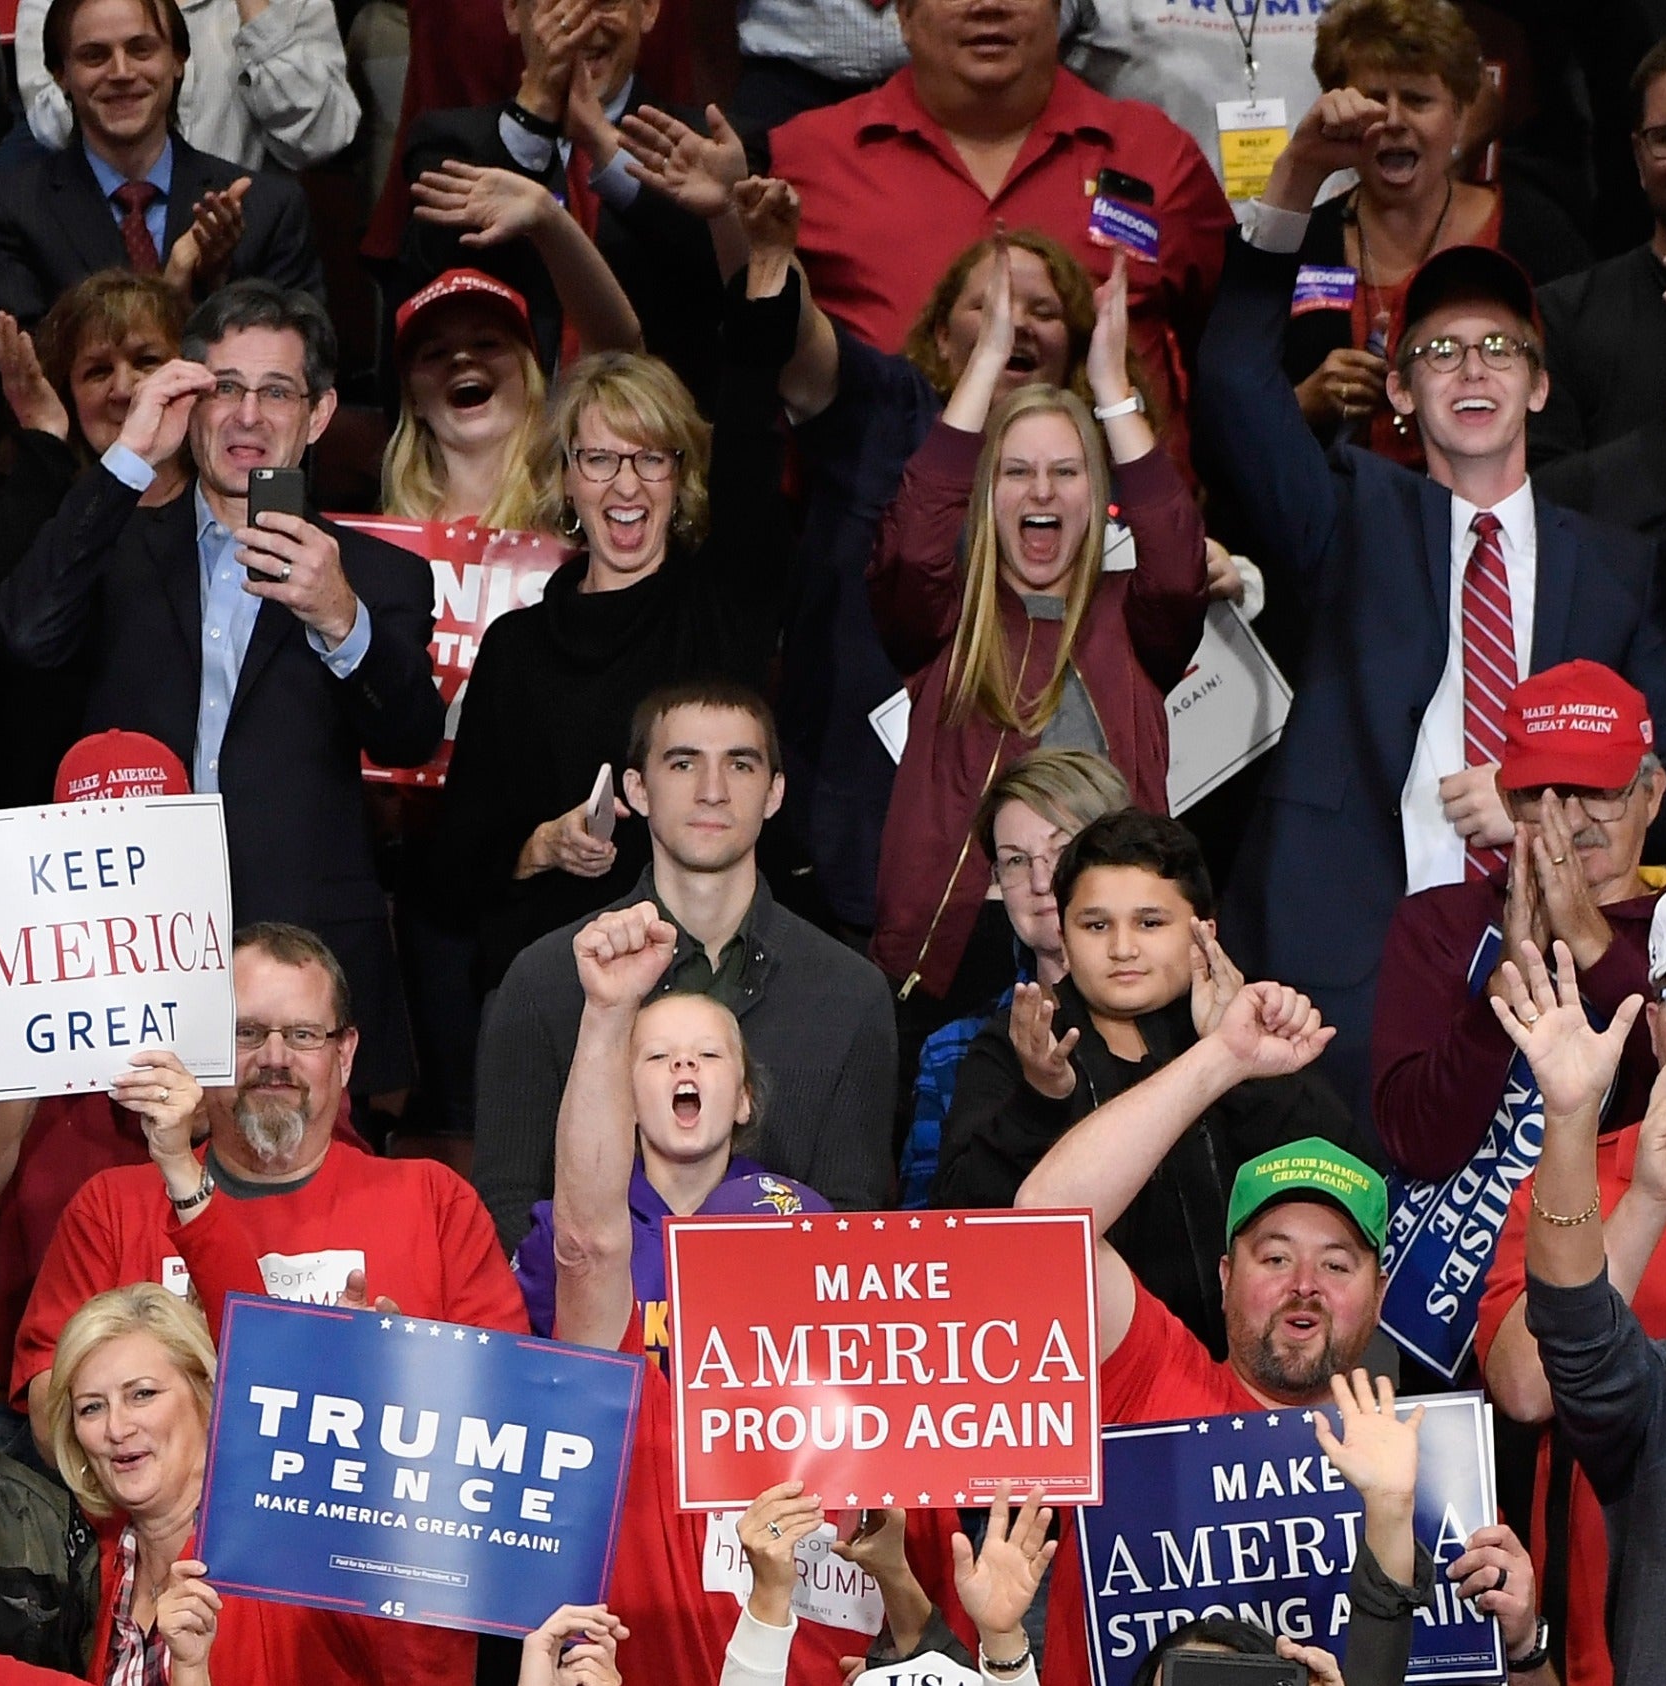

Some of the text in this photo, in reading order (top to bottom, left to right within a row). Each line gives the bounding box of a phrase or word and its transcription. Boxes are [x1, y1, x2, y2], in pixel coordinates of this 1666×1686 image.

[1171, 674, 1223, 718] AGAIN!
[1523, 703, 1618, 720] MAKE AMERICA
[1526, 718, 1612, 734] GREAT AGAIN
[68, 766, 167, 794] MAKE AMERICA
[123, 783, 164, 798] AGAIN
[28, 846, 147, 895] KEEP
[26, 1002, 179, 1054] GREAT
[1255, 1157, 1370, 1191] MAKE OUR FARMERS
[1272, 1170, 1311, 1184] GREAT
[815, 1263, 950, 1301] MAKE
[688, 1317, 1085, 1391] AMERICA
[249, 1386, 594, 1480] TRUMP
[699, 1401, 1073, 1454] PROUD AGAIN
[271, 1450, 555, 1523] PENCE
[1213, 1455, 1346, 1503] MAKE
[254, 1492, 560, 1554] MAKE AMERICA GREAT AGAIN!
[1099, 1502, 1470, 1597] AMERIA
[380, 1600, 405, 1618] 45
